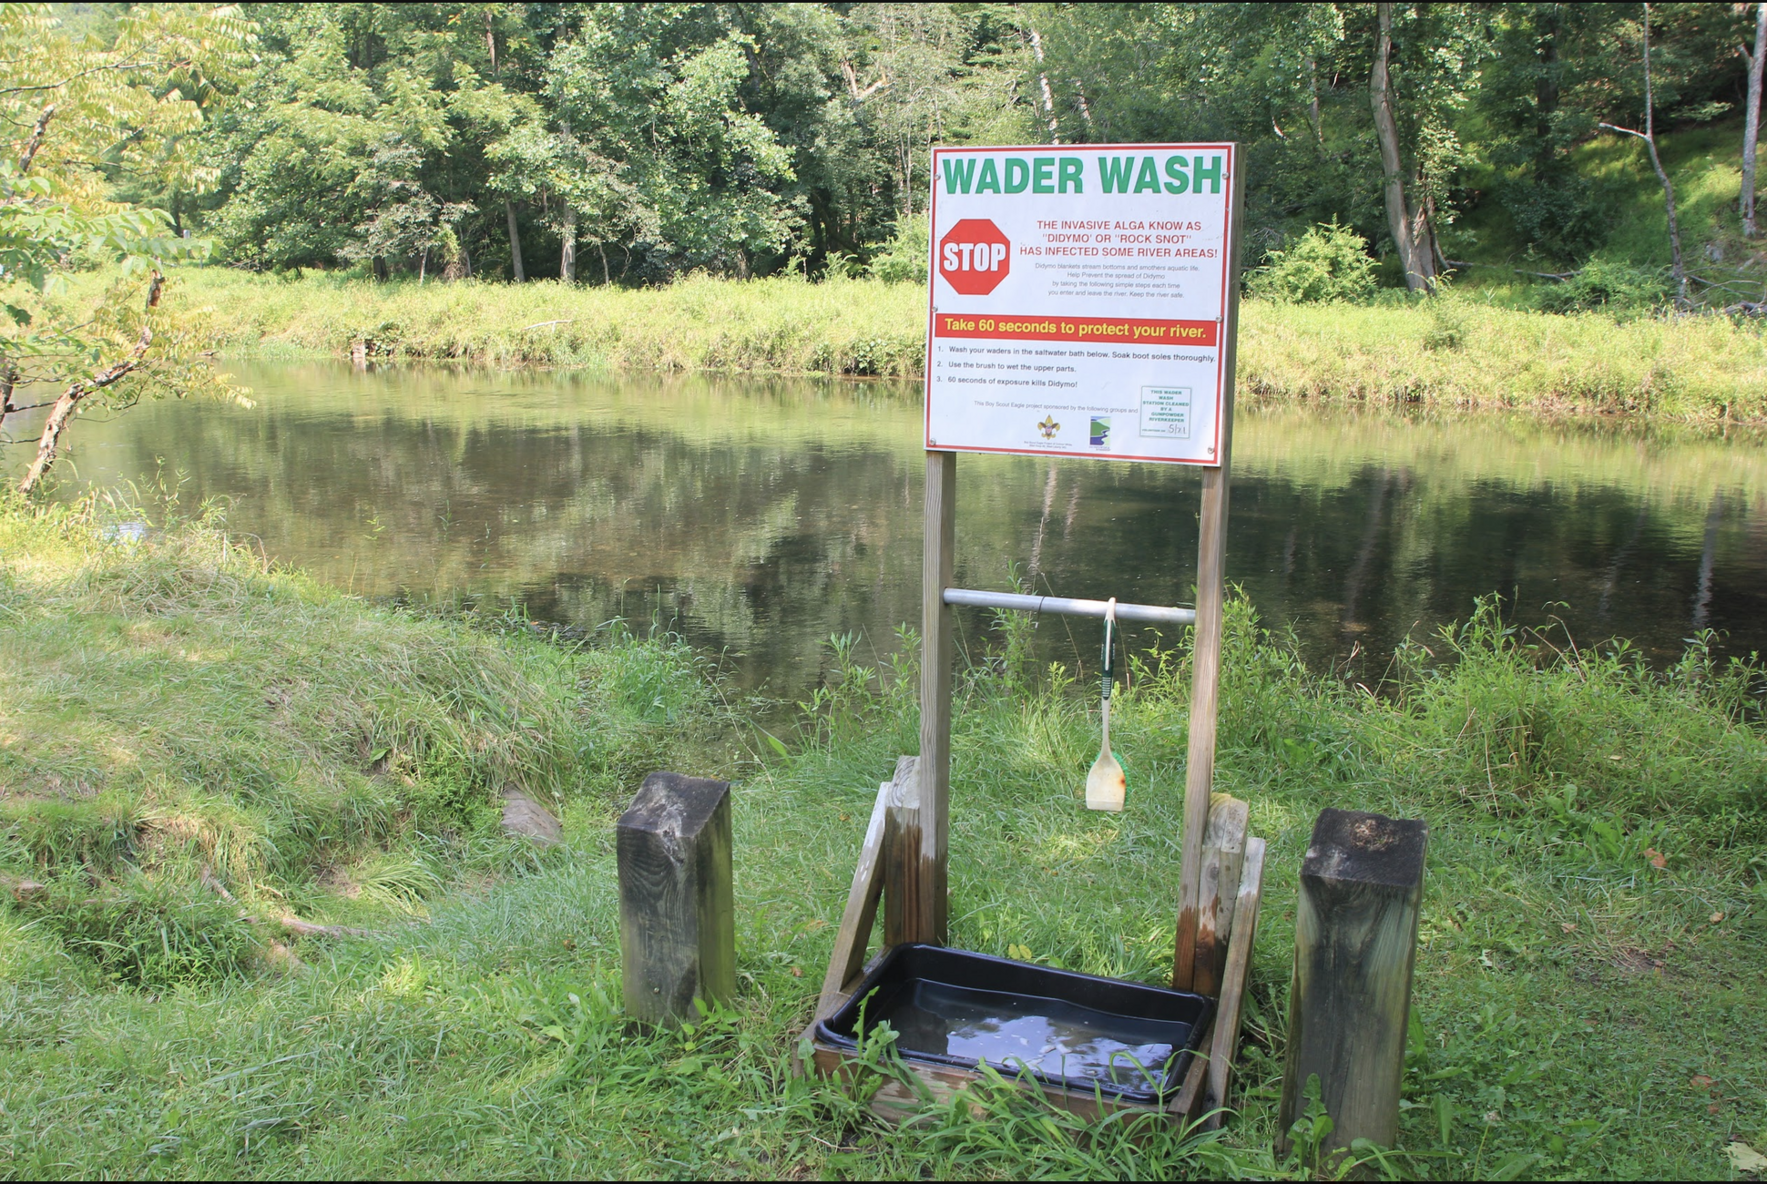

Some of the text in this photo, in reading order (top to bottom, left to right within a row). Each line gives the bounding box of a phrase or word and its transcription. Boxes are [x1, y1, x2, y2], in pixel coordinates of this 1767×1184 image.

[942, 155, 1222, 195] WADER WASH
[1037, 220, 1202, 231] THE INVASIVE ALGA KNOW AS
[1095, 234, 1112, 243] OR
[943, 242, 1006, 273] STOP
[1019, 246, 1218, 258] HAS INFECTED SOME RIVER AREAS!
[1035, 262, 1056, 270] Didymo
[944, 318, 1207, 339] Take 60 seconds to protect your river.
[1112, 351, 1131, 359] Soak
[1173, 353, 1216, 363] thoroughly.
[1033, 365, 1054, 373] upper
[1056, 365, 1077, 373] parts.
[997, 378, 1030, 386] exposure
[1031, 378, 1047, 387] kills
[1047, 380, 1078, 389] Didymo!
